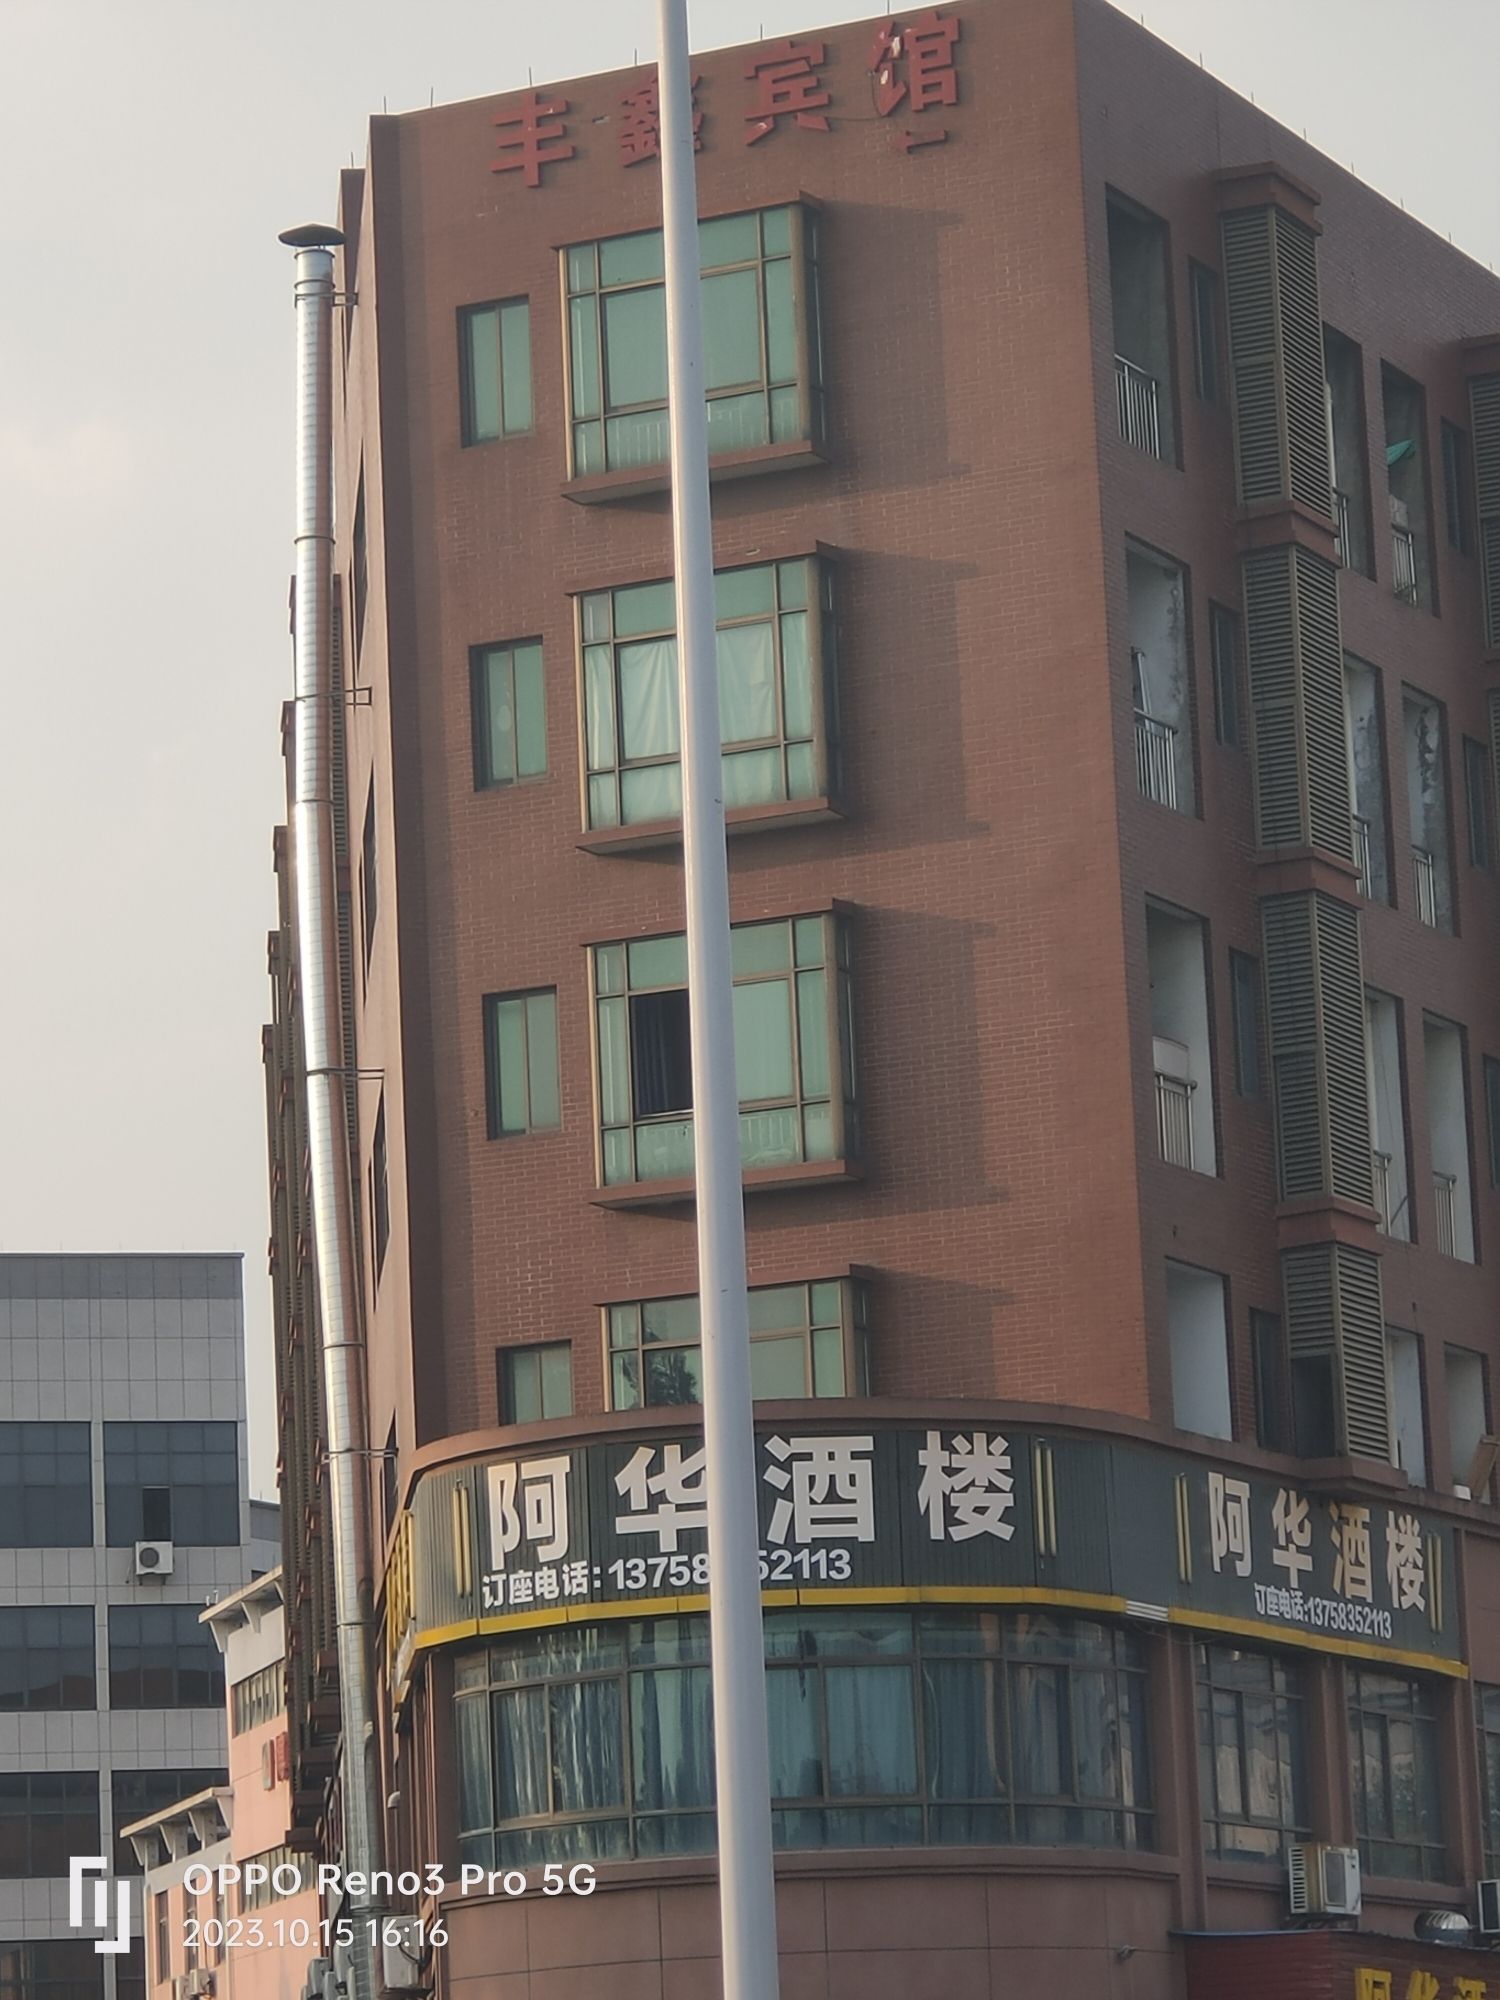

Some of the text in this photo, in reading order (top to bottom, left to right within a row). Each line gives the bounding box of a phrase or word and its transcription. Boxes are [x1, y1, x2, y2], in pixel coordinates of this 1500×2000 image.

[487, 1430, 1016, 1570] 阿华酒楼
[1208, 1471, 1426, 1613] 阿华酒楼
